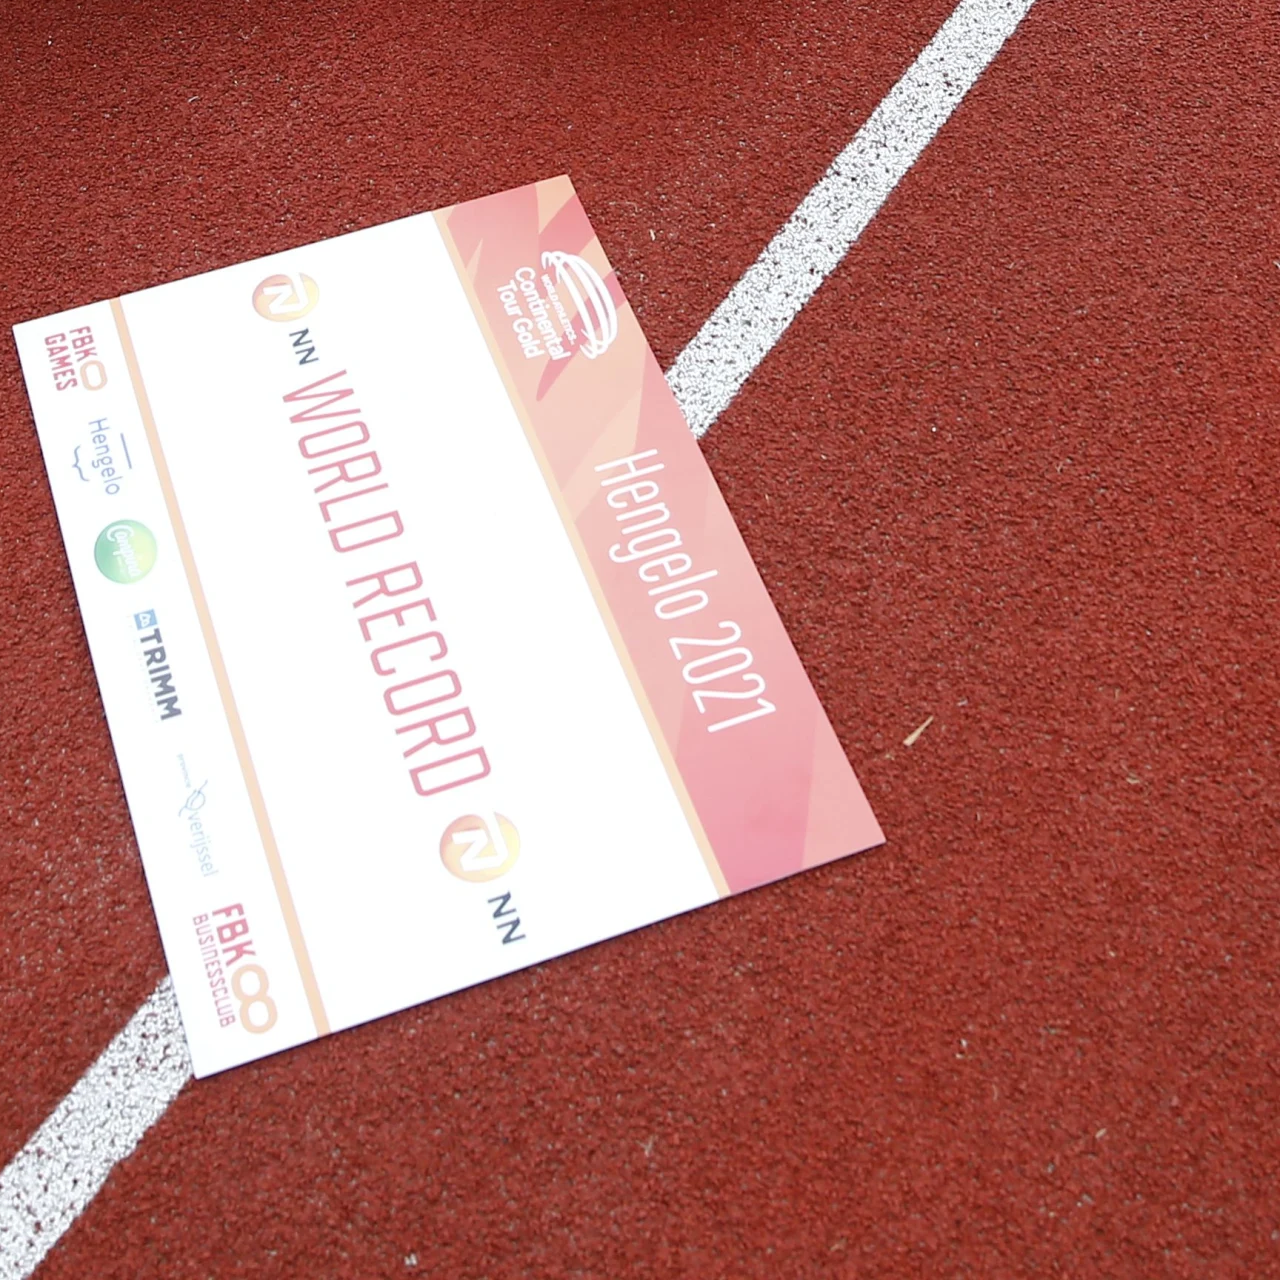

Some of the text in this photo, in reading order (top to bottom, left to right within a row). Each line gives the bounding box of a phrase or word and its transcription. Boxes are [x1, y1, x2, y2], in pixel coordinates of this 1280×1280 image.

[69, 325, 98, 362] FBK
[289, 327, 319, 365] NN
[497, 279, 545, 359] Tour Gold
[515, 267, 571, 360] Continental
[44, 333, 78, 391] GAMES
[88, 417, 123, 496] Hengelo
[282, 369, 492, 797] WORLD RECORD
[594, 448, 777, 733] Hengelo 2021
[139, 628, 182, 721] TRIMM
[212, 902, 257, 967] FBK
[487, 891, 527, 945] NN
[192, 913, 236, 1028] BUSINESSCLUB
